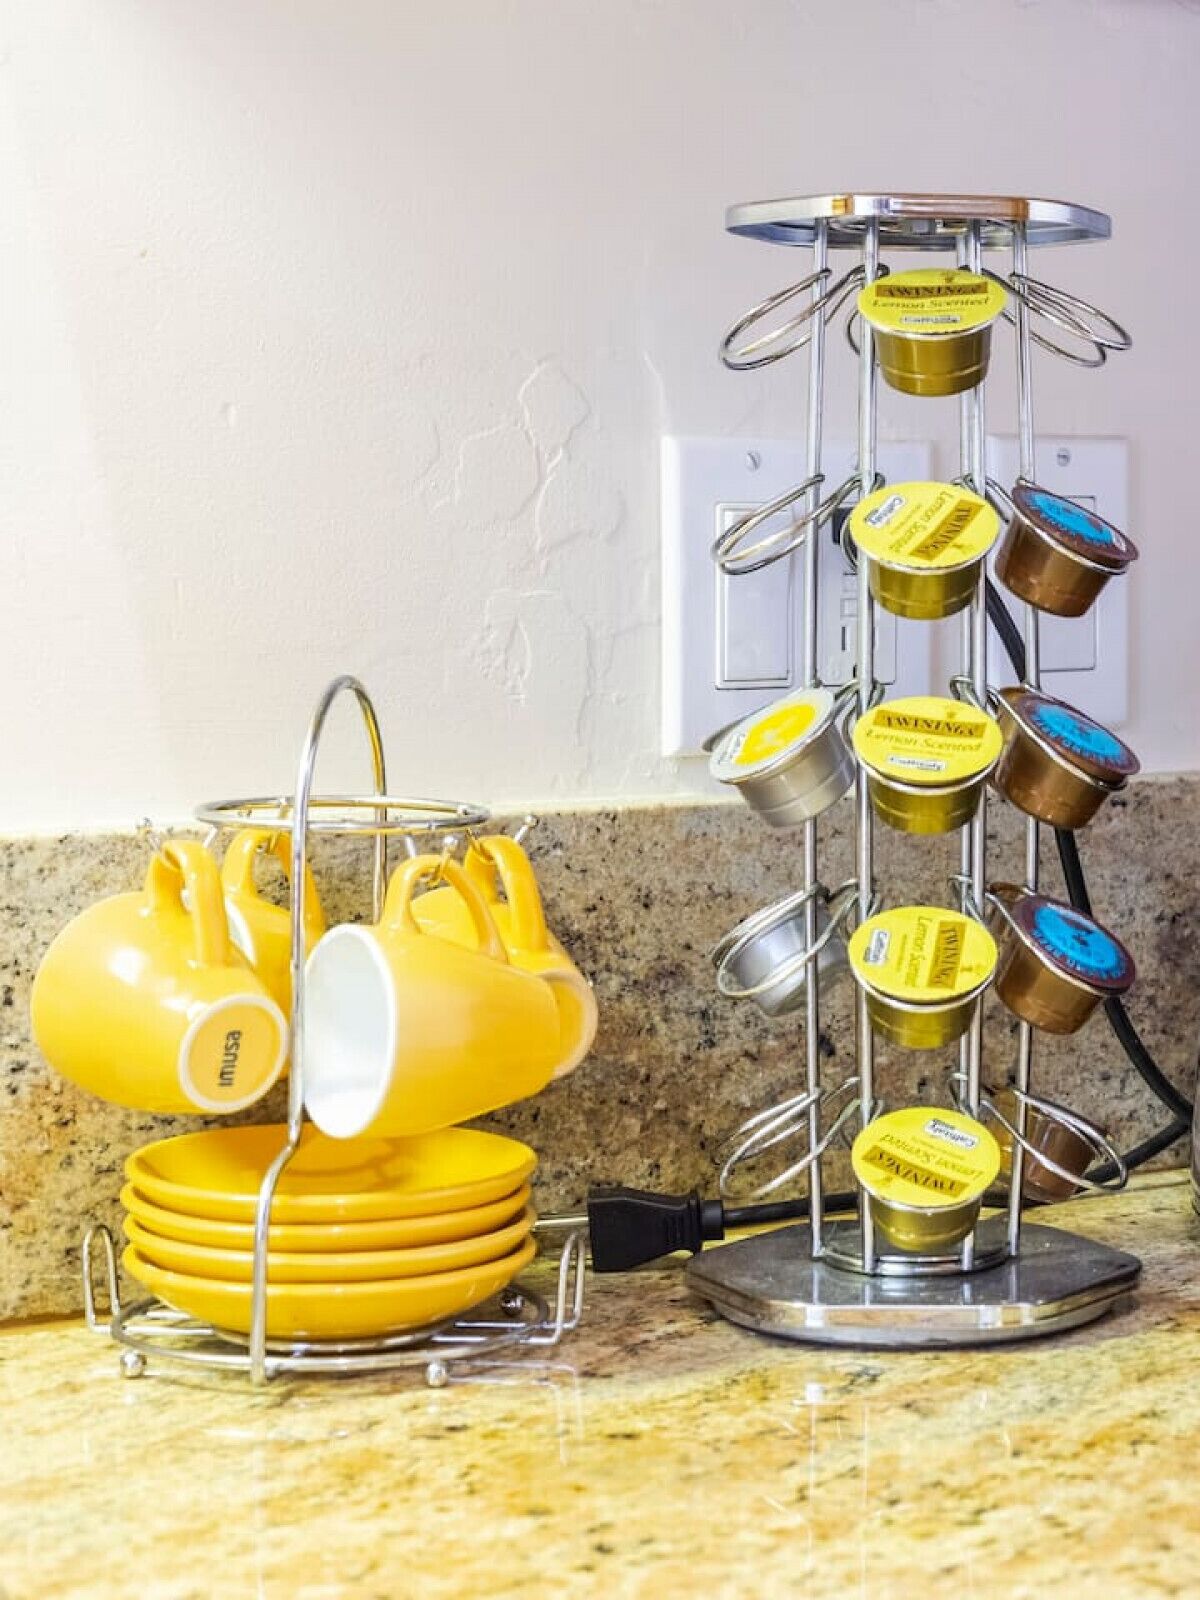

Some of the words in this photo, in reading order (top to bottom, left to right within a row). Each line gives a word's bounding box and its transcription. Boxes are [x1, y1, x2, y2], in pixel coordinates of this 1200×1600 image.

[886, 284, 979, 297] TWININGS
[872, 299, 925, 309] Lemon
[930, 297, 990, 308] Scented
[886, 714, 975, 736] TWININGS
[866, 728, 918, 746] Lemon
[924, 737, 982, 754] Scented
[217, 1030, 242, 1087] imusa
